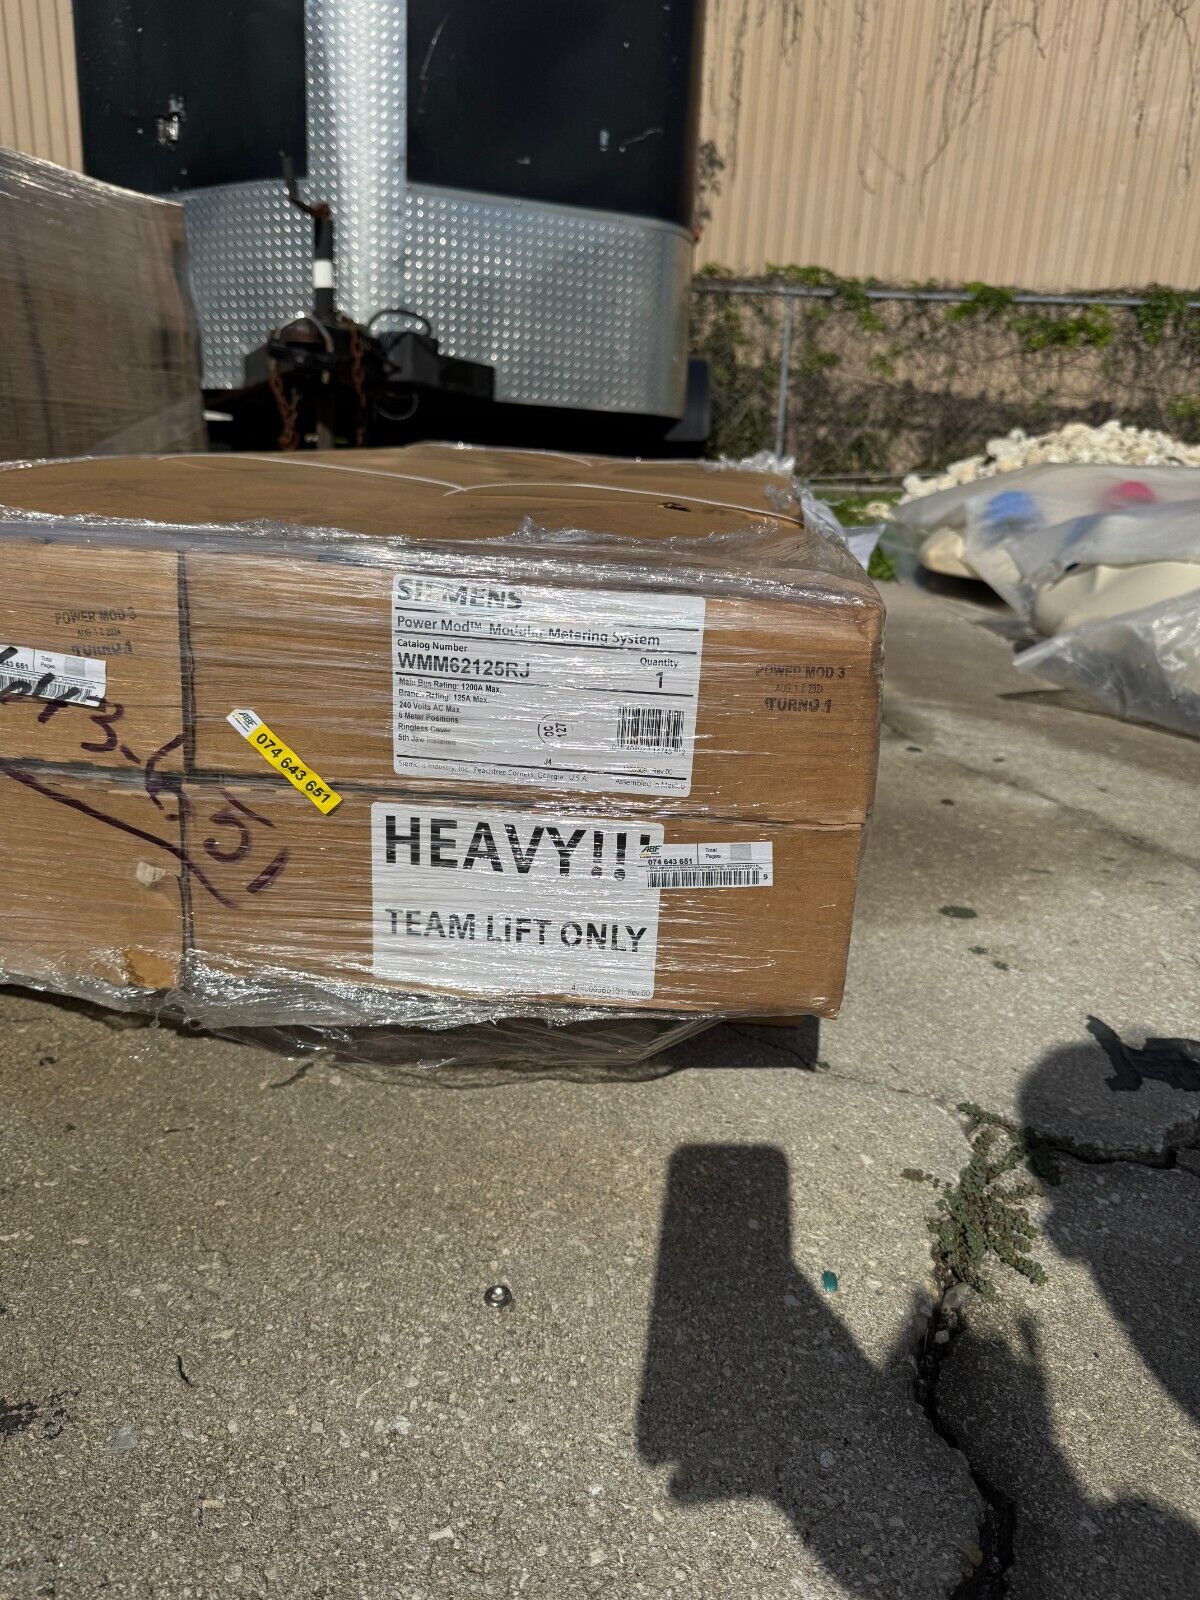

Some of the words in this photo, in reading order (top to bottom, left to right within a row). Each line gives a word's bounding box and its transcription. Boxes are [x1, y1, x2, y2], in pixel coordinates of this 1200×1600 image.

[397, 578, 523, 609] SIMENS
[397, 615, 437, 630] Power
[548, 628, 608, 645] Metering
[612, 631, 660, 647] System
[397, 639, 430, 651] Catalog
[432, 642, 468, 653] Number
[15, 661, 29, 670] 651
[397, 652, 530, 679] WMM62125RJ
[640, 657, 679, 670] Quantity
[838, 666, 847, 679] 3
[418, 678, 432, 687] Bus
[433, 680, 460, 691] Rating:
[461, 682, 484, 692] 1200A
[485, 685, 502, 694] Max.
[655, 671, 664, 689] 1
[453, 694, 472, 703] 125A
[472, 696, 490, 704] Max.
[399, 701, 412, 709] 240
[413, 702, 432, 711] Volts
[433, 704, 445, 712] AC
[823, 699, 833, 714] 1
[238, 712, 259, 726] ABF
[404, 712, 424, 720] Meter
[426, 713, 460, 724] Positions
[398, 722, 429, 733] Ringless
[398, 733, 410, 742] 5th
[256, 733, 284, 759] 074
[280, 756, 307, 781] 643
[305, 780, 332, 804] 651
[473, 766, 507, 777] Peachtree
[615, 778, 652, 787] Assembled
[641, 845, 662, 854] ABF
[663, 858, 678, 866] 643
[679, 857, 693, 865] 651
[385, 908, 476, 941] TEAM
[487, 915, 552, 945] LIFT
[560, 921, 648, 953] ONLY
